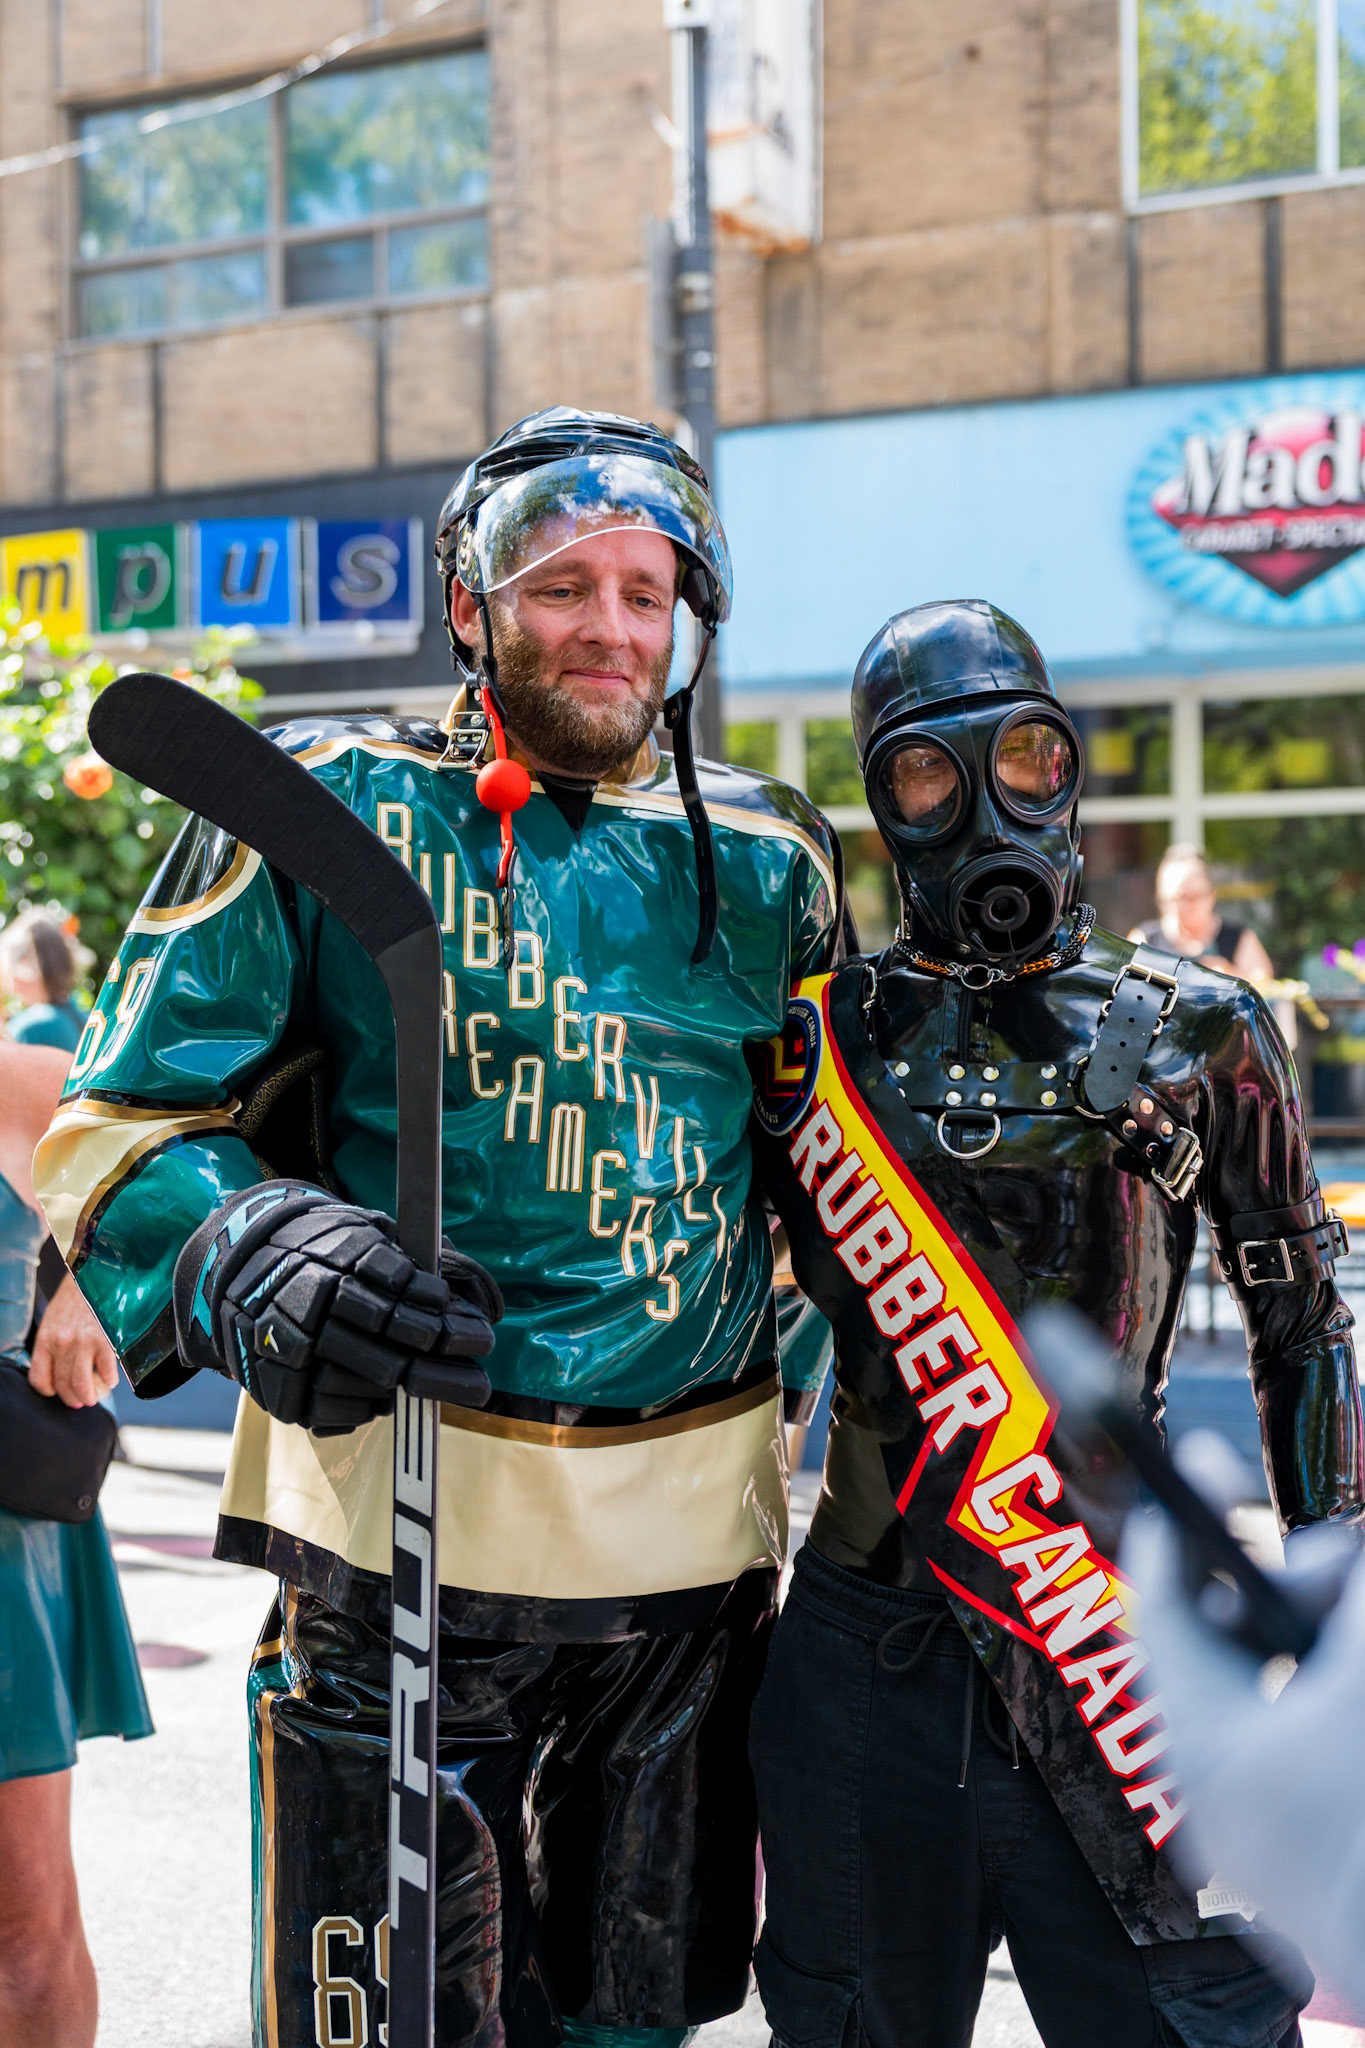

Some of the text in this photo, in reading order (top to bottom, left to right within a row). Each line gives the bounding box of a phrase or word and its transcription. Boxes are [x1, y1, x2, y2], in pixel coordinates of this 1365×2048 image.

[14, 533, 401, 628] mpus
[1178, 409, 1365, 517] Mad
[788, 1098, 1191, 1851] RUBBER CANADA
[390, 1385, 433, 1929] TRUE
